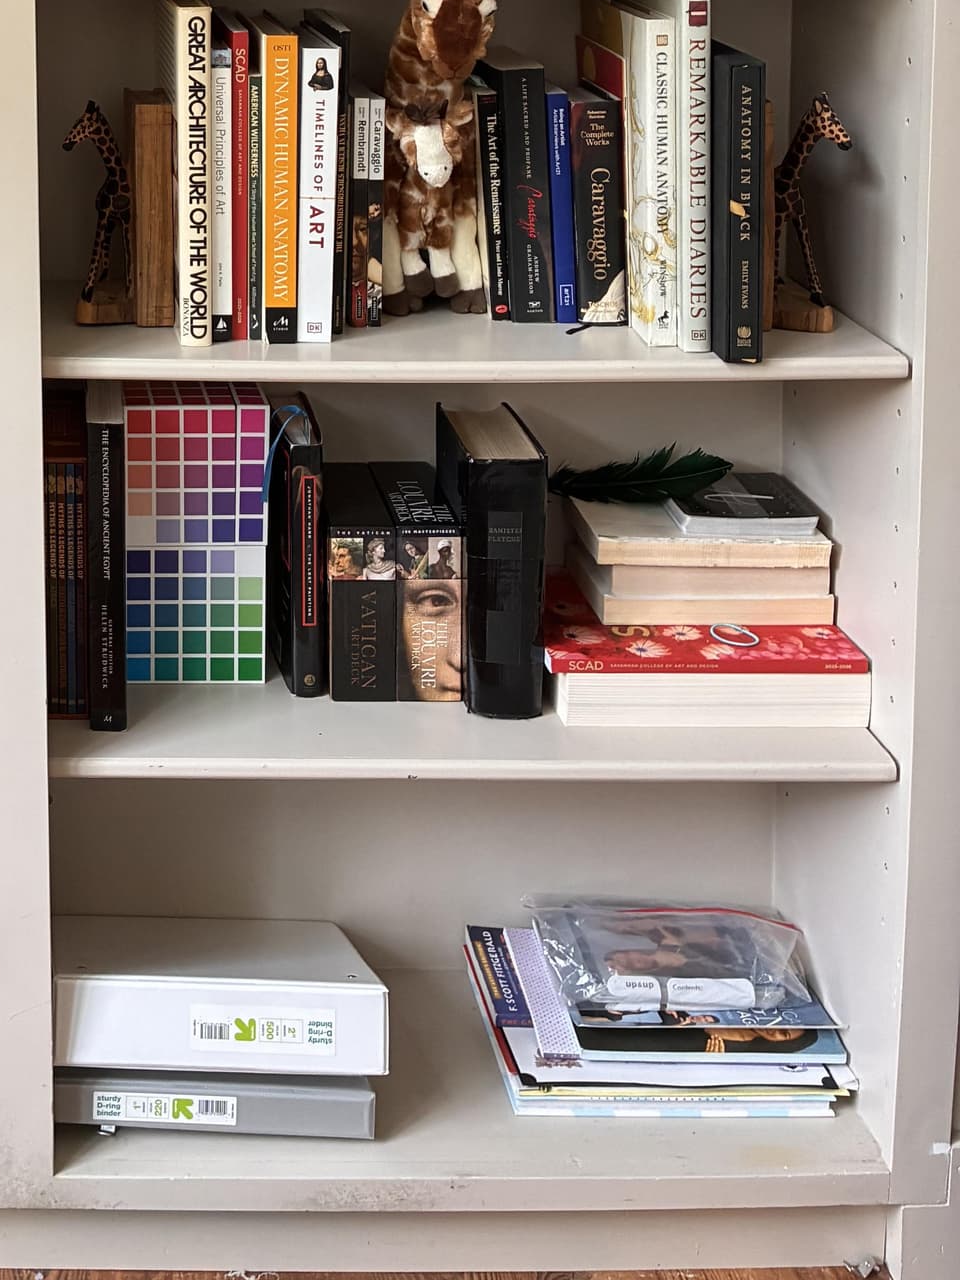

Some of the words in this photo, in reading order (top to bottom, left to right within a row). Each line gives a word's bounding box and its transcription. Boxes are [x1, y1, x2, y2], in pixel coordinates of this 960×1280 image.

[188, 17, 205, 73] GREAT
[236, 48, 246, 82] SCAD
[274, 57, 290, 140] DYNAMIC
[487, 114, 497, 133] The
[690, 38, 706, 208] REMARKABLE
[189, 76, 206, 204] ARCHITECTURE
[315, 99, 325, 169] TIMELINES
[357, 120, 366, 173] Rembrandt
[370, 121, 383, 174] Caravaggio
[488, 135, 498, 149] Art
[489, 152, 499, 162] of
[274, 142, 290, 210] HUMAN
[314, 174, 323, 192] OF
[490, 163, 499, 177] the
[189, 211, 206, 233] OF
[309, 205, 324, 249] ART
[491, 179, 502, 234] Renaissance
[587, 168, 611, 281] Caravaggio
[190, 237, 206, 266] THE
[274, 216, 289, 302] ANATOMY
[690, 219, 707, 318] DIARIES
[190, 269, 207, 339] WORLD
[103, 507, 110, 518] OF
[361, 592, 377, 689] VATICAN
[420, 621, 436, 689] LOUVRE
[569, 661, 604, 671] SCAD
